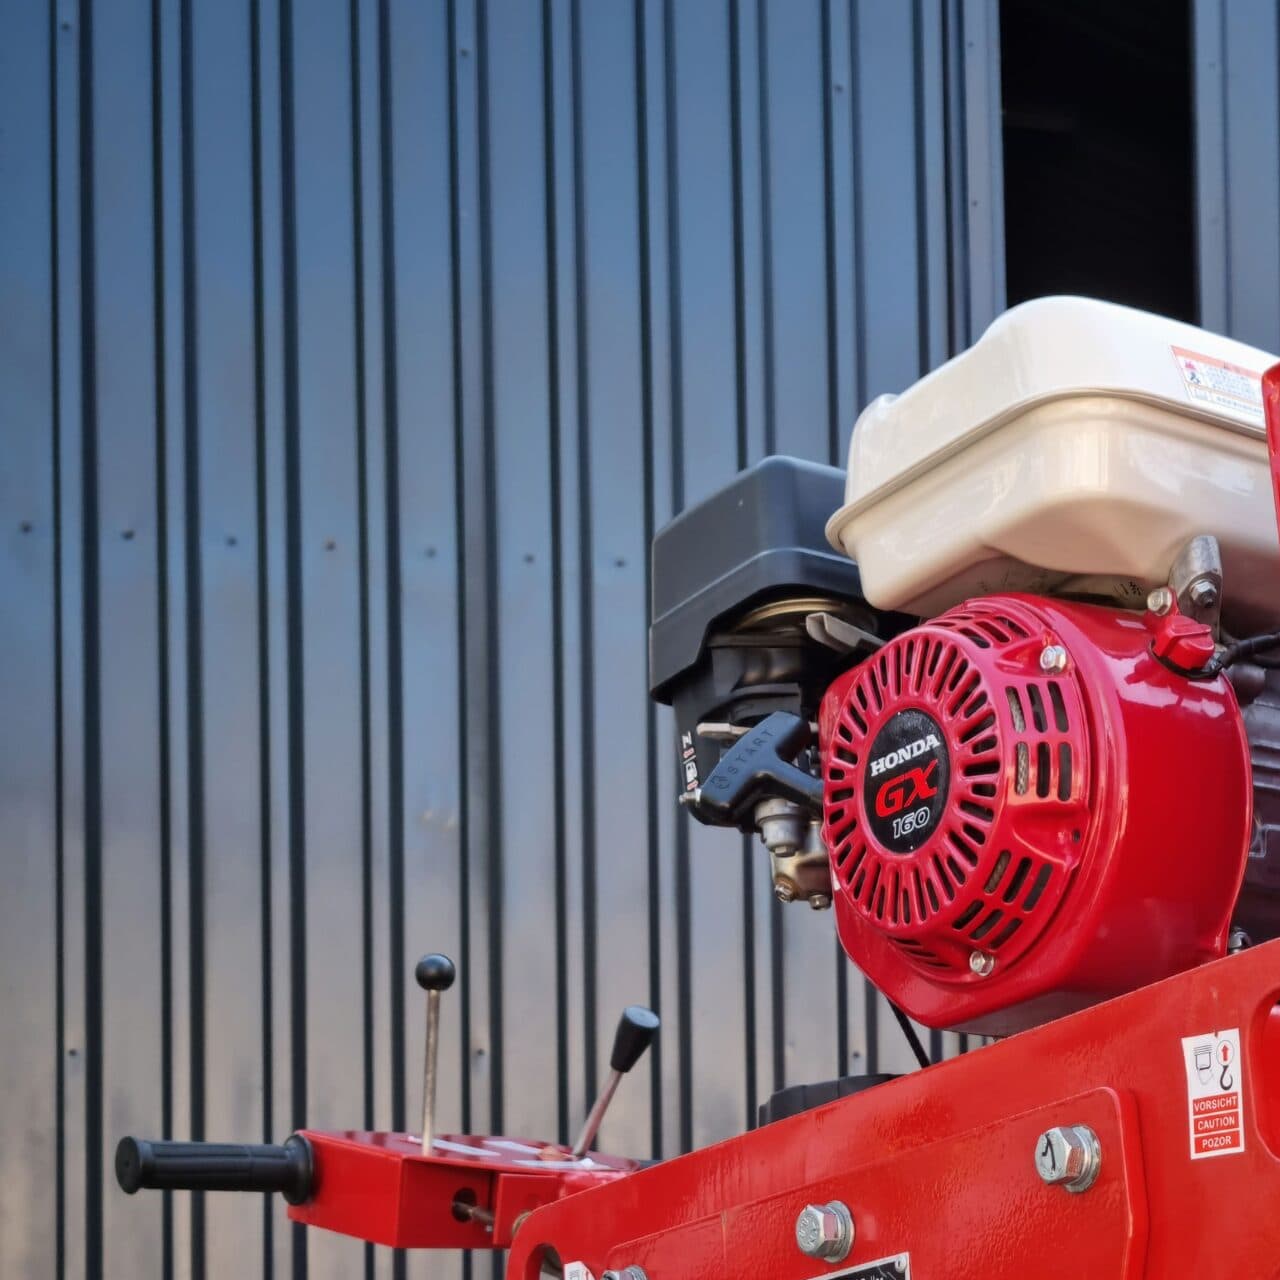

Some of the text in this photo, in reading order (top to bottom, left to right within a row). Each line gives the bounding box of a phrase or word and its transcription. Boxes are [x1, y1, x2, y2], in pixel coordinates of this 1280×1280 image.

[727, 729, 775, 776] START
[870, 733, 941, 777] HONDA
[875, 758, 938, 818] GX
[892, 806, 930, 840] 160
[1193, 1096, 1237, 1112] VORSICHT
[1197, 1116, 1235, 1130] CAUTION
[1202, 1135, 1232, 1149] POZOR
